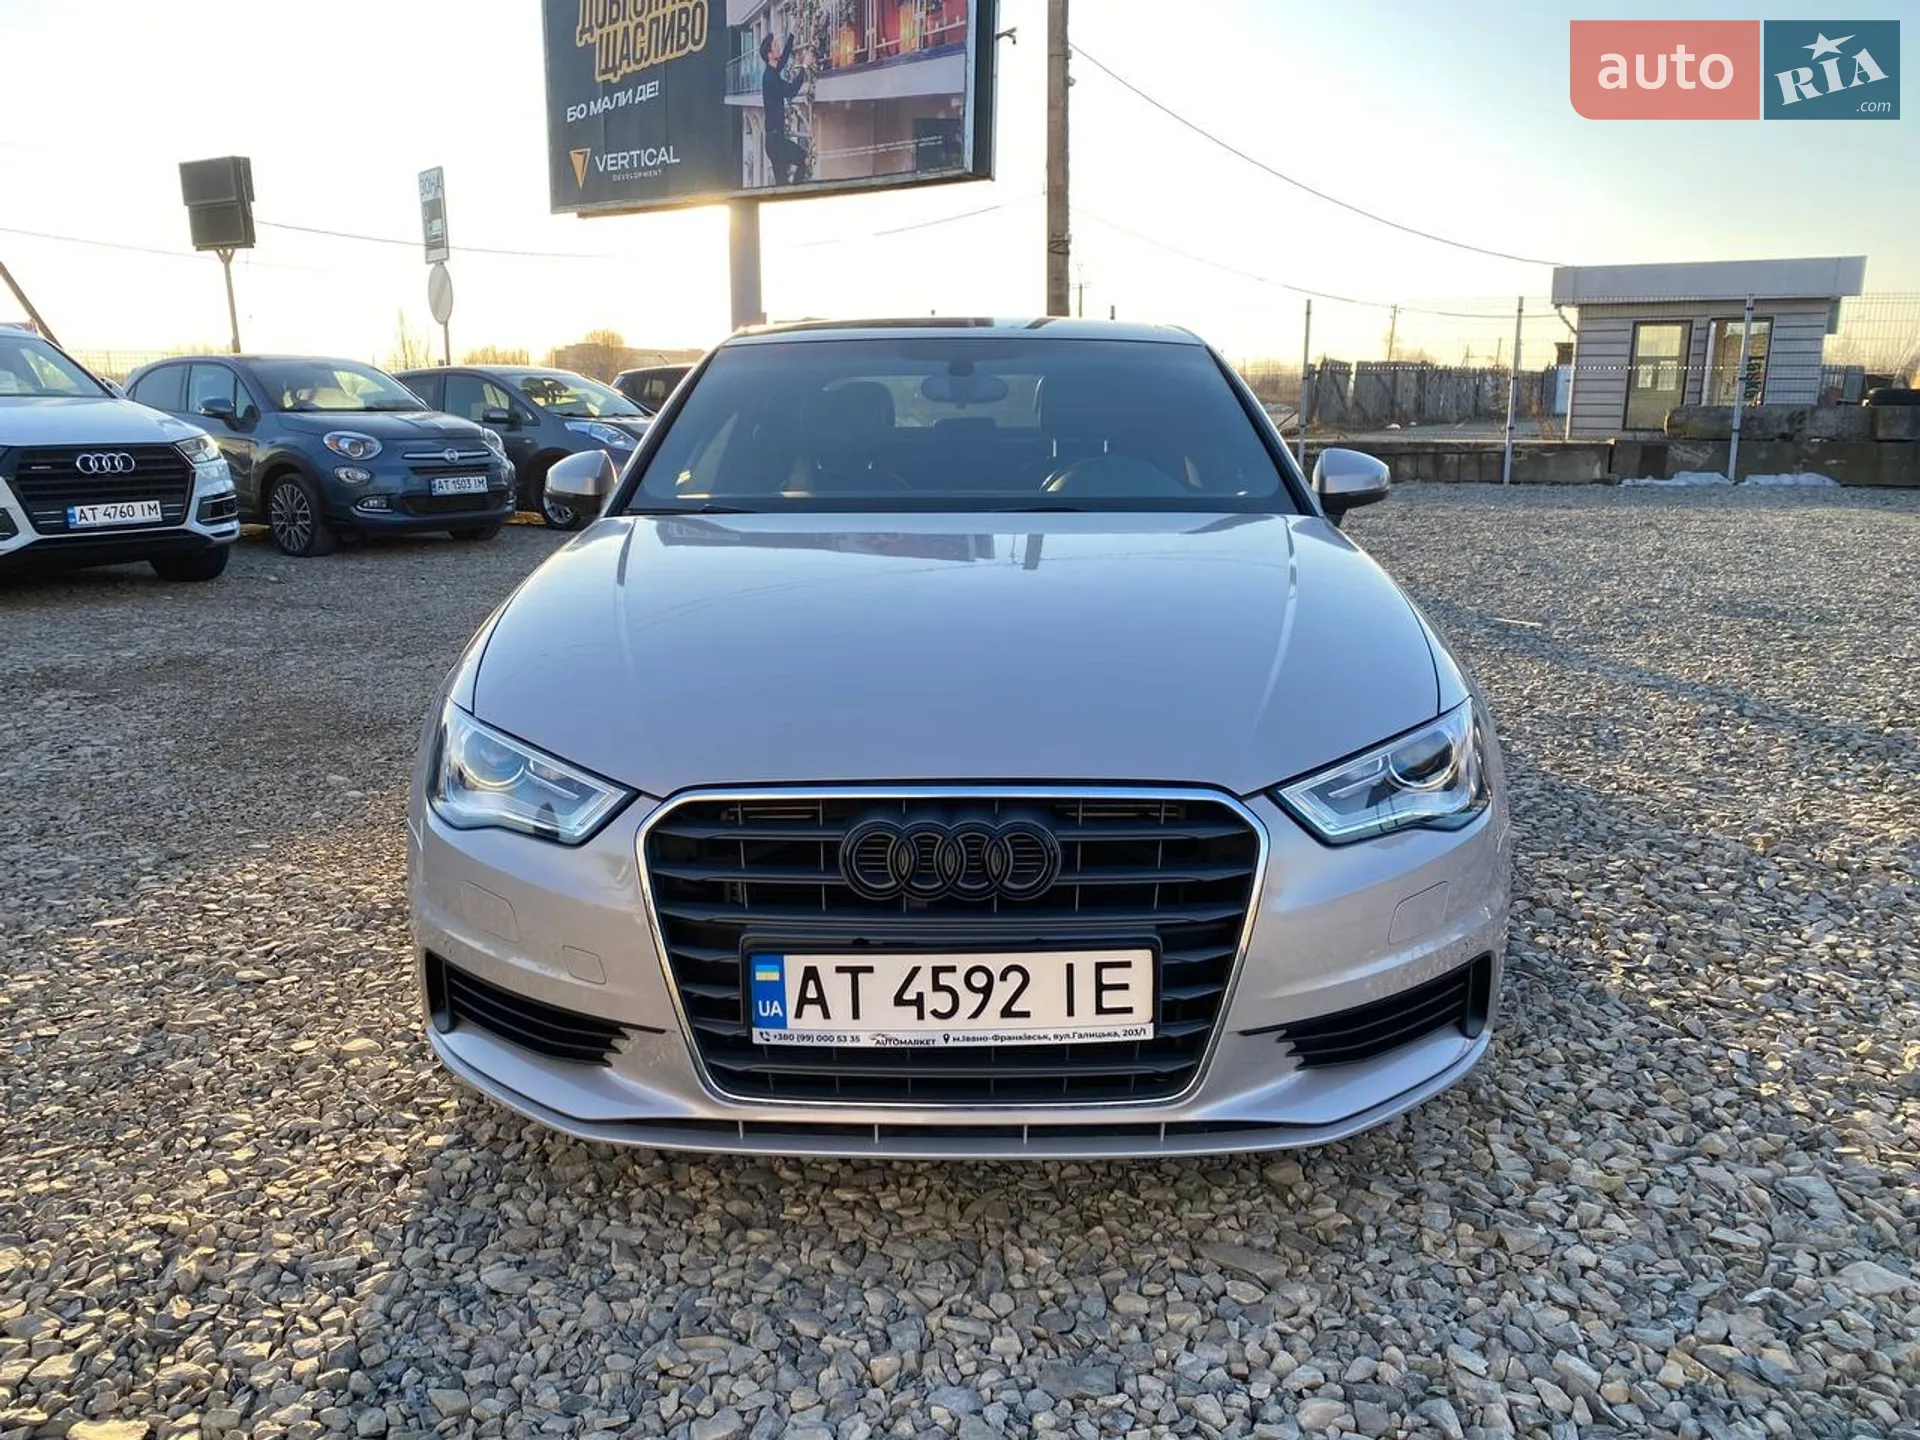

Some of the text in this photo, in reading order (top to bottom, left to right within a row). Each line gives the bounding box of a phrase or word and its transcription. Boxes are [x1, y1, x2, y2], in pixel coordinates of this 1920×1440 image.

[597, 2, 706, 80] ЩАСЛИВО
[566, 80, 660, 123] БО МАЛИ ДЕ!
[595, 145, 681, 173] VERTICAL
[612, 168, 662, 181] DEVELOPMENT
[78, 503, 159, 522] AT 4760 IM
[793, 960, 1134, 1021] AT 4592 IE
[758, 1001, 783, 1017] UA
[773, 1033, 794, 1042] +380
[796, 1033, 815, 1043] (99)
[816, 1034, 835, 1043] 000
[1122, 1028, 1147, 1037] 203/1
[875, 1037, 937, 1046] AUTOMARKET
